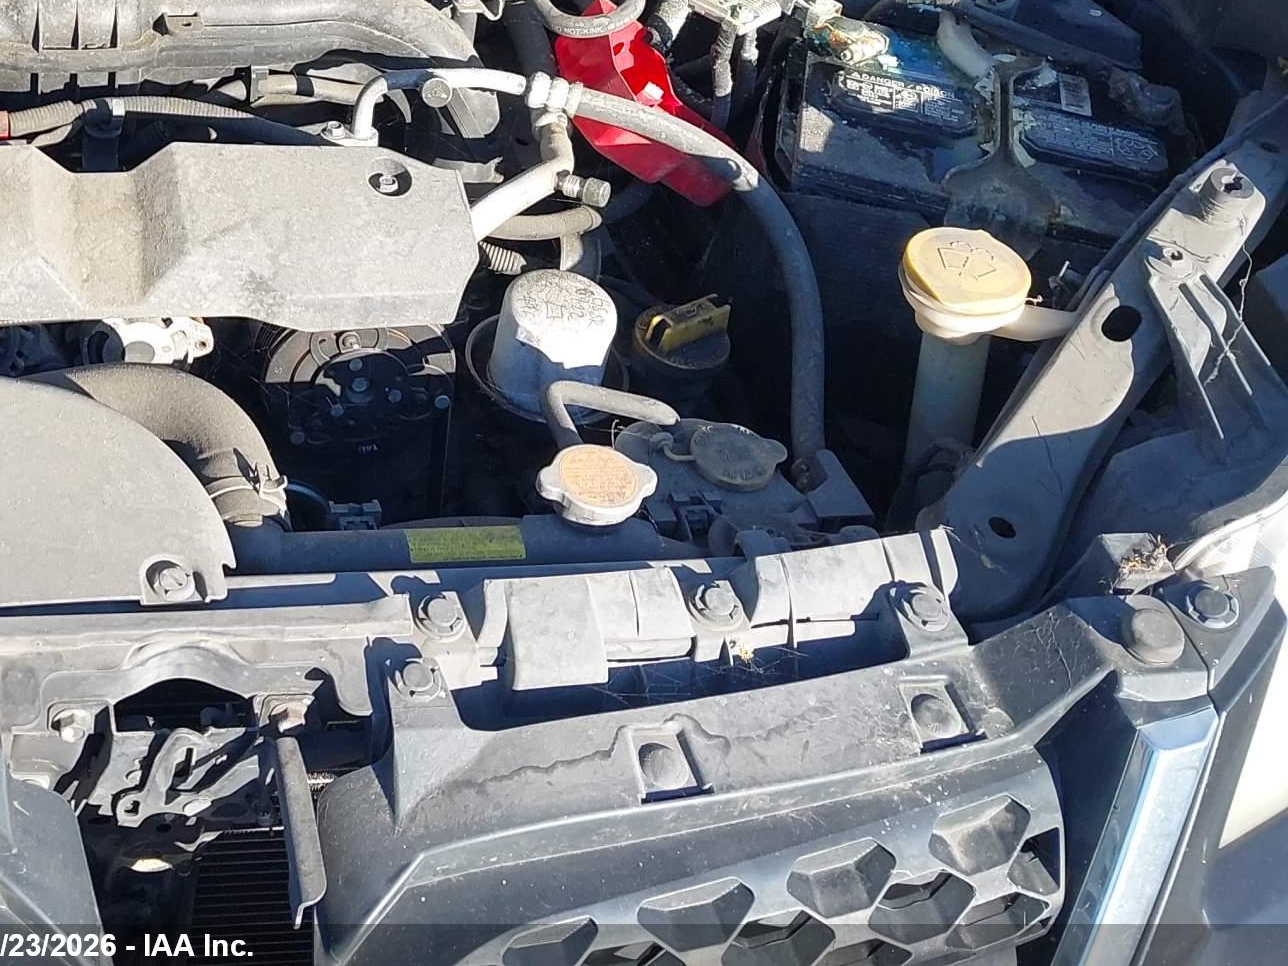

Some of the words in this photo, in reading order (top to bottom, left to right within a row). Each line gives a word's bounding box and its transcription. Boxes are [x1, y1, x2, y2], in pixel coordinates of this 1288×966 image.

[564, 27, 581, 35] NOT
[861, 73, 905, 88] DANGER
[915, 84, 955, 99] POISON
